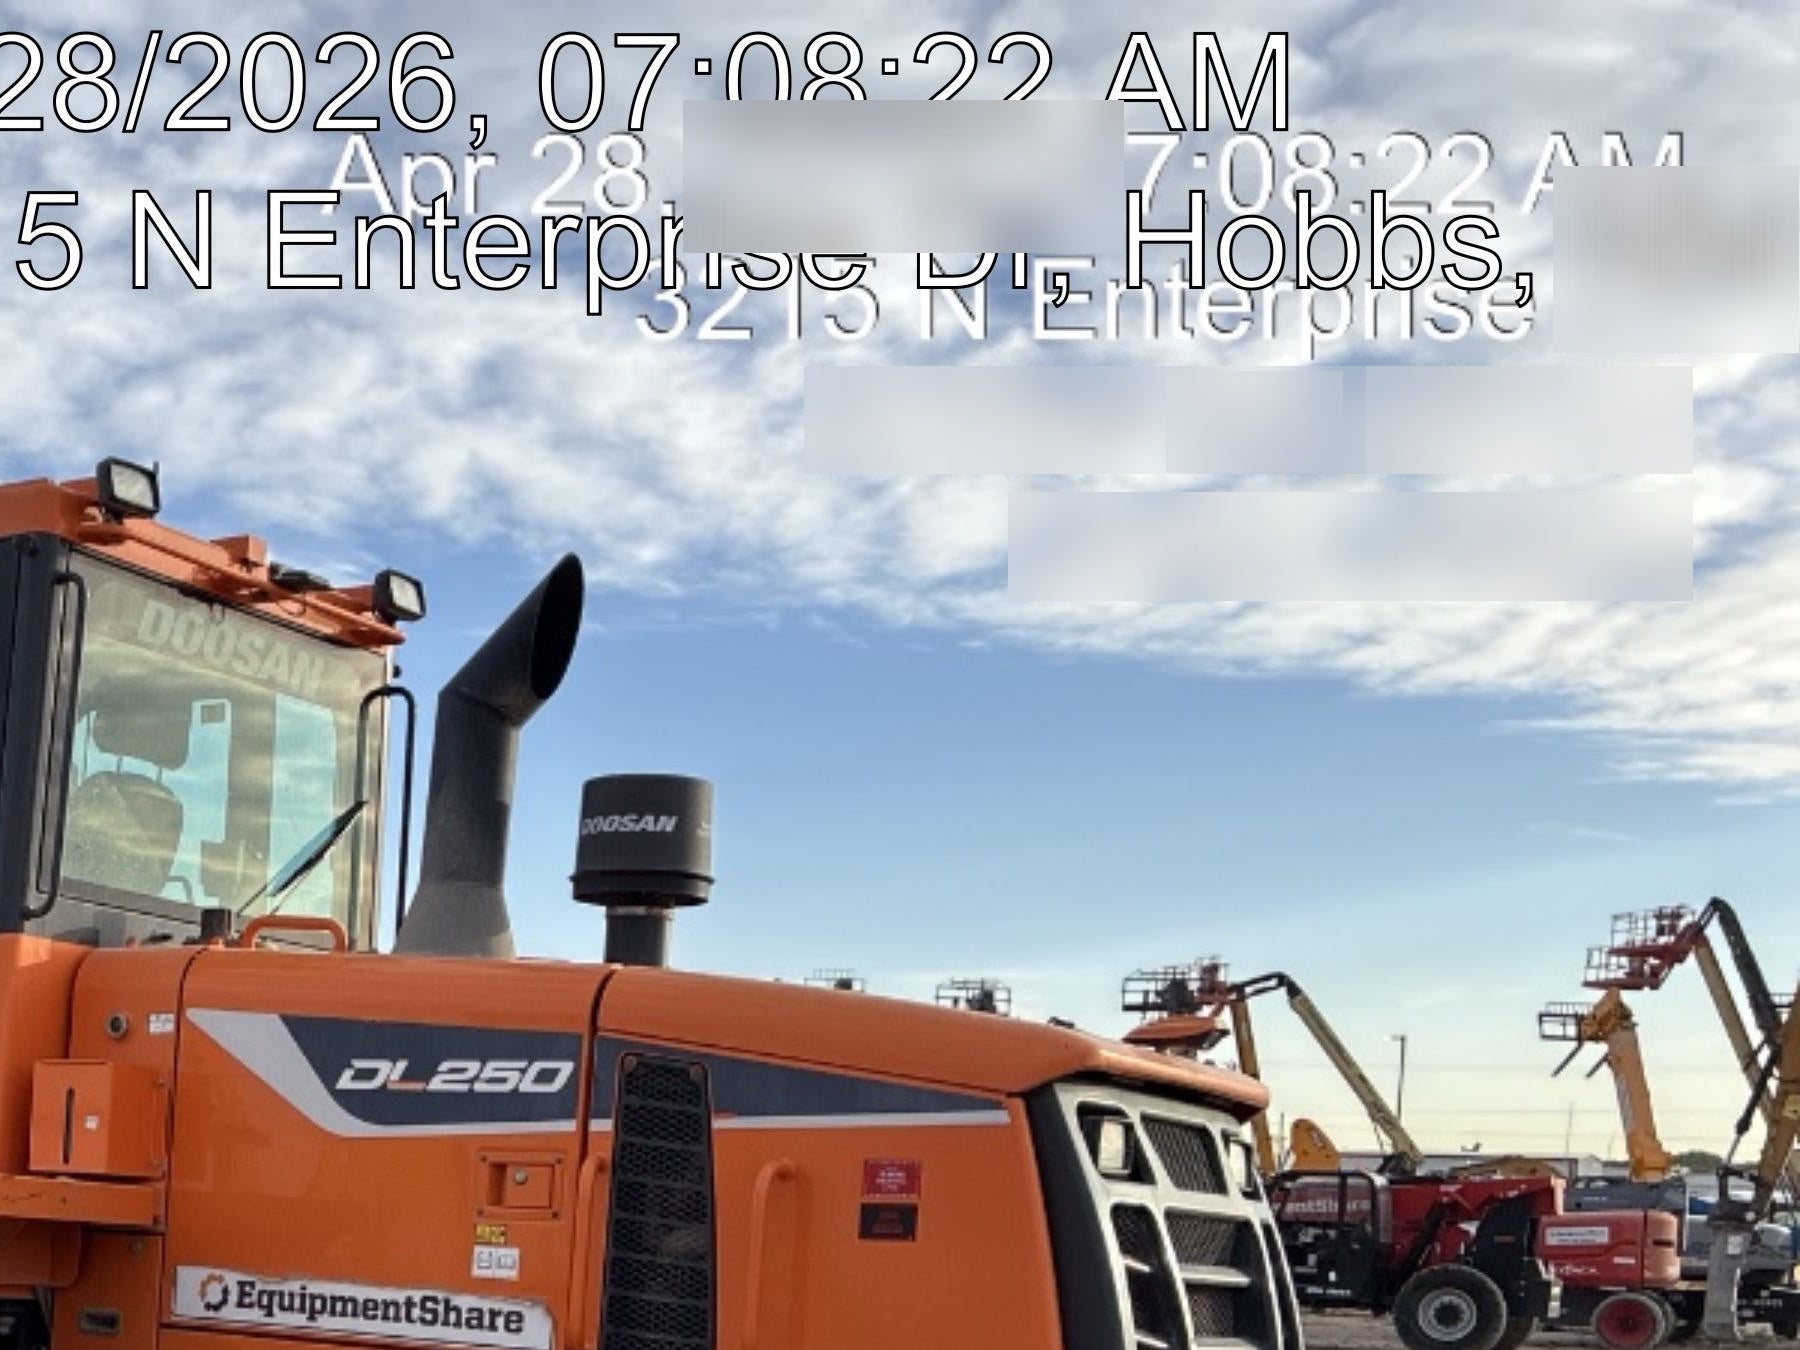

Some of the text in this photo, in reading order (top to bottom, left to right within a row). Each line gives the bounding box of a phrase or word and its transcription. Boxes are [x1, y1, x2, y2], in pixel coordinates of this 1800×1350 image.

[137, 600, 326, 697] DOOSAN
[581, 813, 679, 835] DOOSAN
[335, 1057, 574, 1093] DL250
[236, 1280, 525, 1334] EquipmentShare
